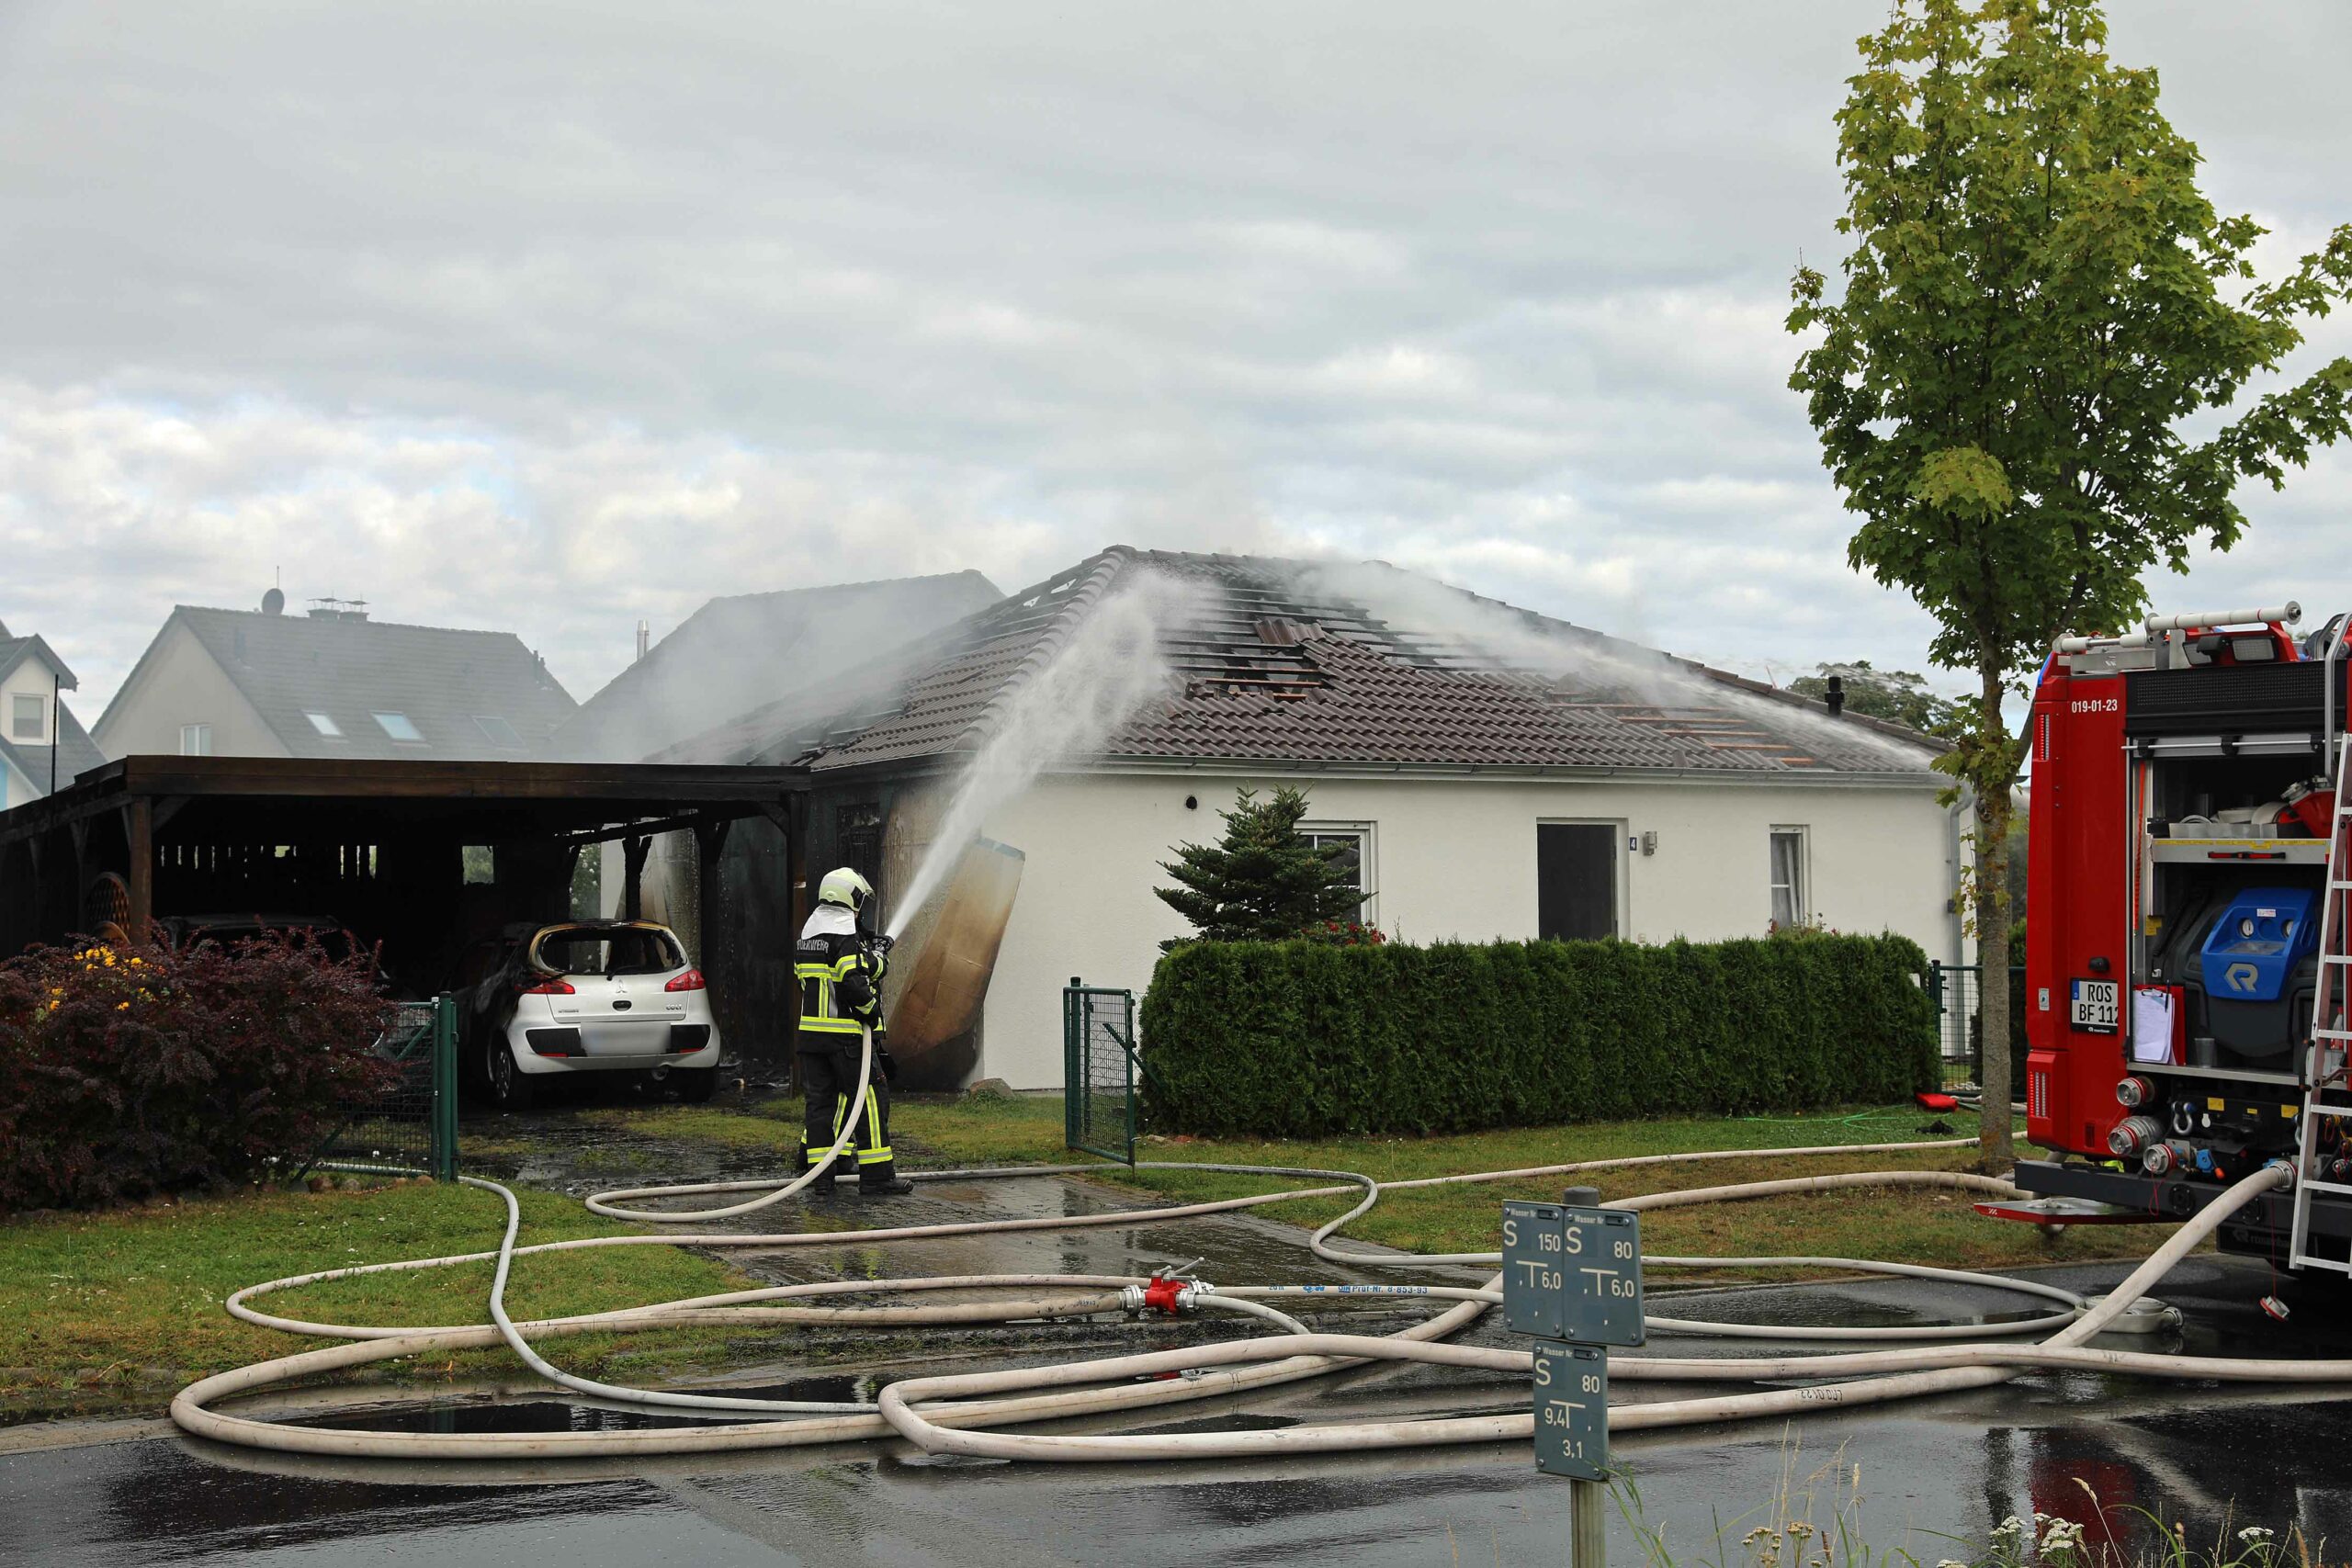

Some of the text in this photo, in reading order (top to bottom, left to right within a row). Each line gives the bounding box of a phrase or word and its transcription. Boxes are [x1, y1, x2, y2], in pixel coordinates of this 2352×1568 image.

[2071, 699, 2118, 713] 019-01-23
[2088, 984, 2112, 1003] ROS
[2080, 1004, 2095, 1021] BF
[1510, 1208, 1529, 1217] Wasser
[1503, 1220, 1560, 1252] S 150
[1566, 1227, 1633, 1259] S 80
[1542, 1272, 1561, 1290] 6,0
[1611, 1279, 1635, 1297] 6,0
[1543, 1347, 1564, 1357] Wasser
[1535, 1358, 1600, 1393] S 80
[1545, 1407, 1565, 1427] 9,4
[1562, 1439, 1583, 1459] 3,1
